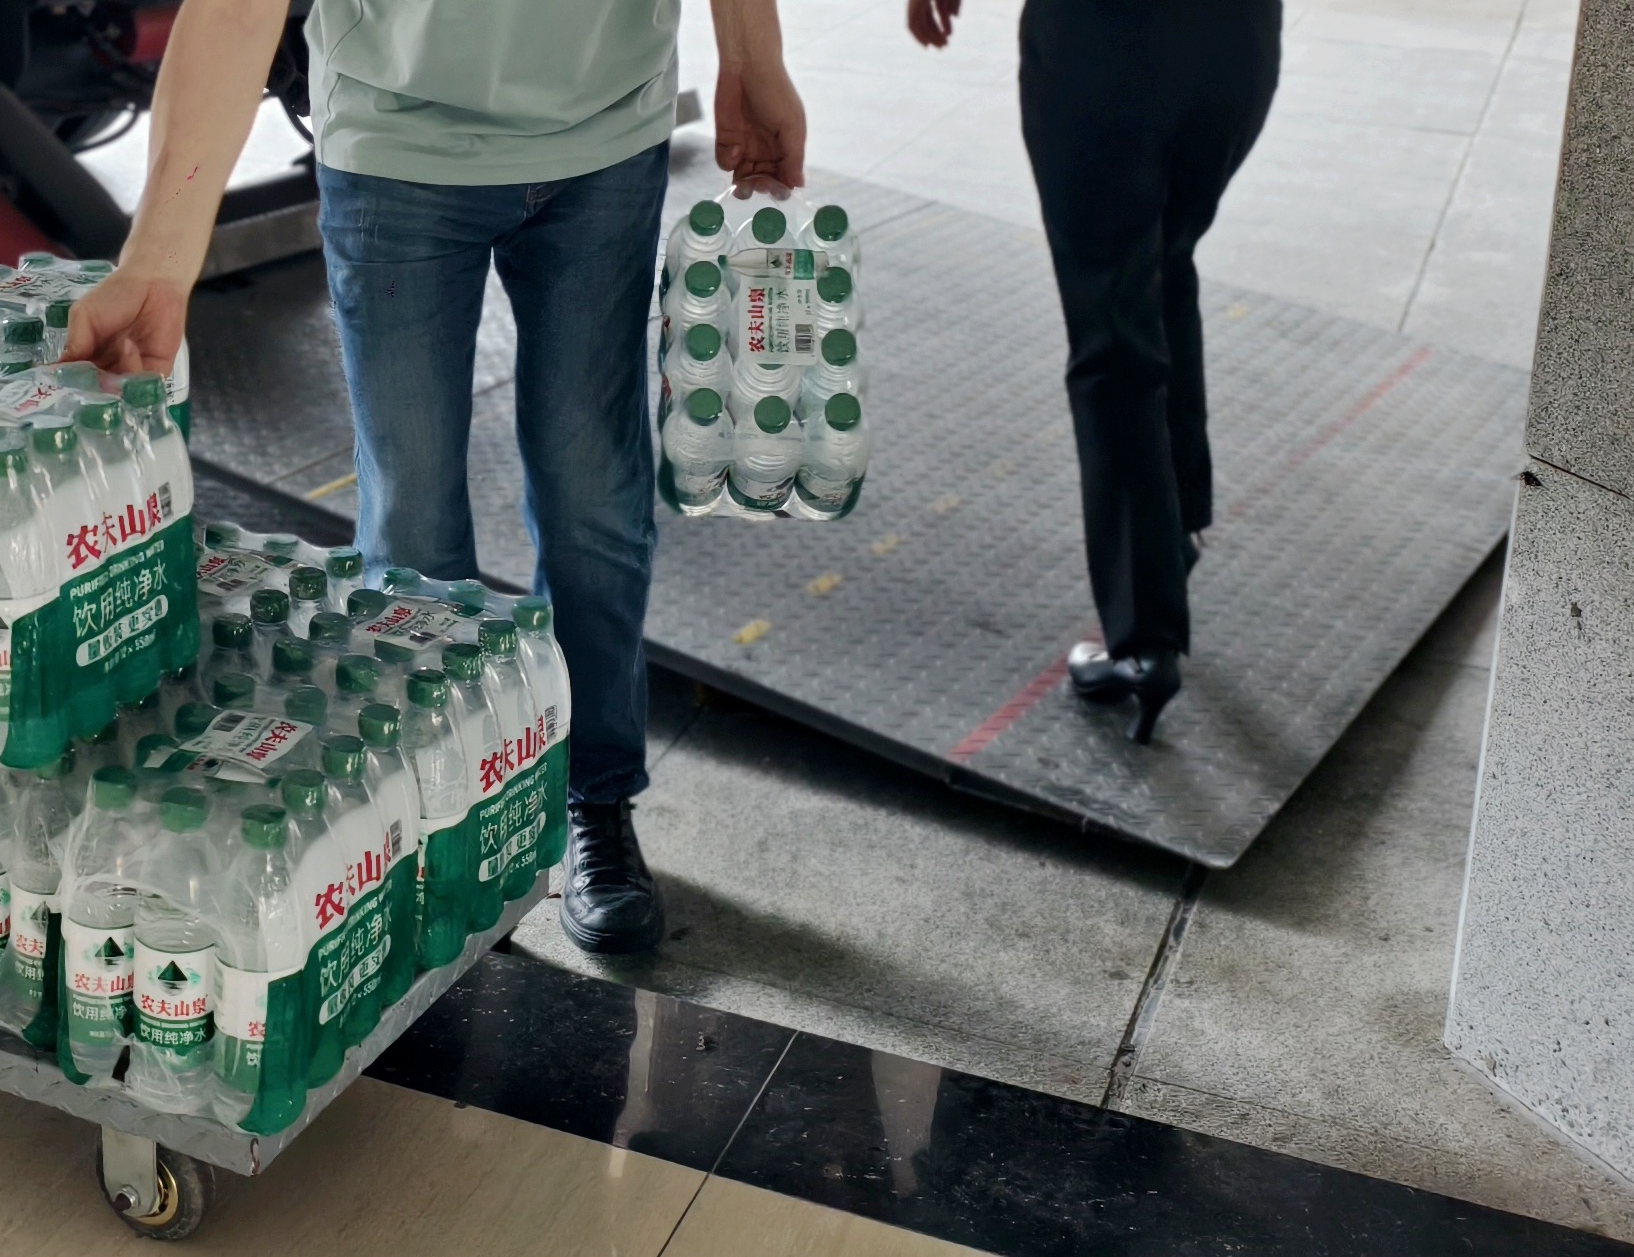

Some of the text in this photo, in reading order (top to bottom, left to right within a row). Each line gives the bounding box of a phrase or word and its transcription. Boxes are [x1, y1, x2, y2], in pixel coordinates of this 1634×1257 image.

[748, 287, 766, 353] 农夫山泉
[67, 491, 162, 570] 农夫山泉
[72, 559, 167, 638] 饮用纯净水
[479, 713, 546, 794] 农夫山泉
[479, 779, 548, 855] 饮用纯净水
[140, 1024, 207, 1046] 饮用纯净水
[141, 994, 207, 1018] 农夫山泉
